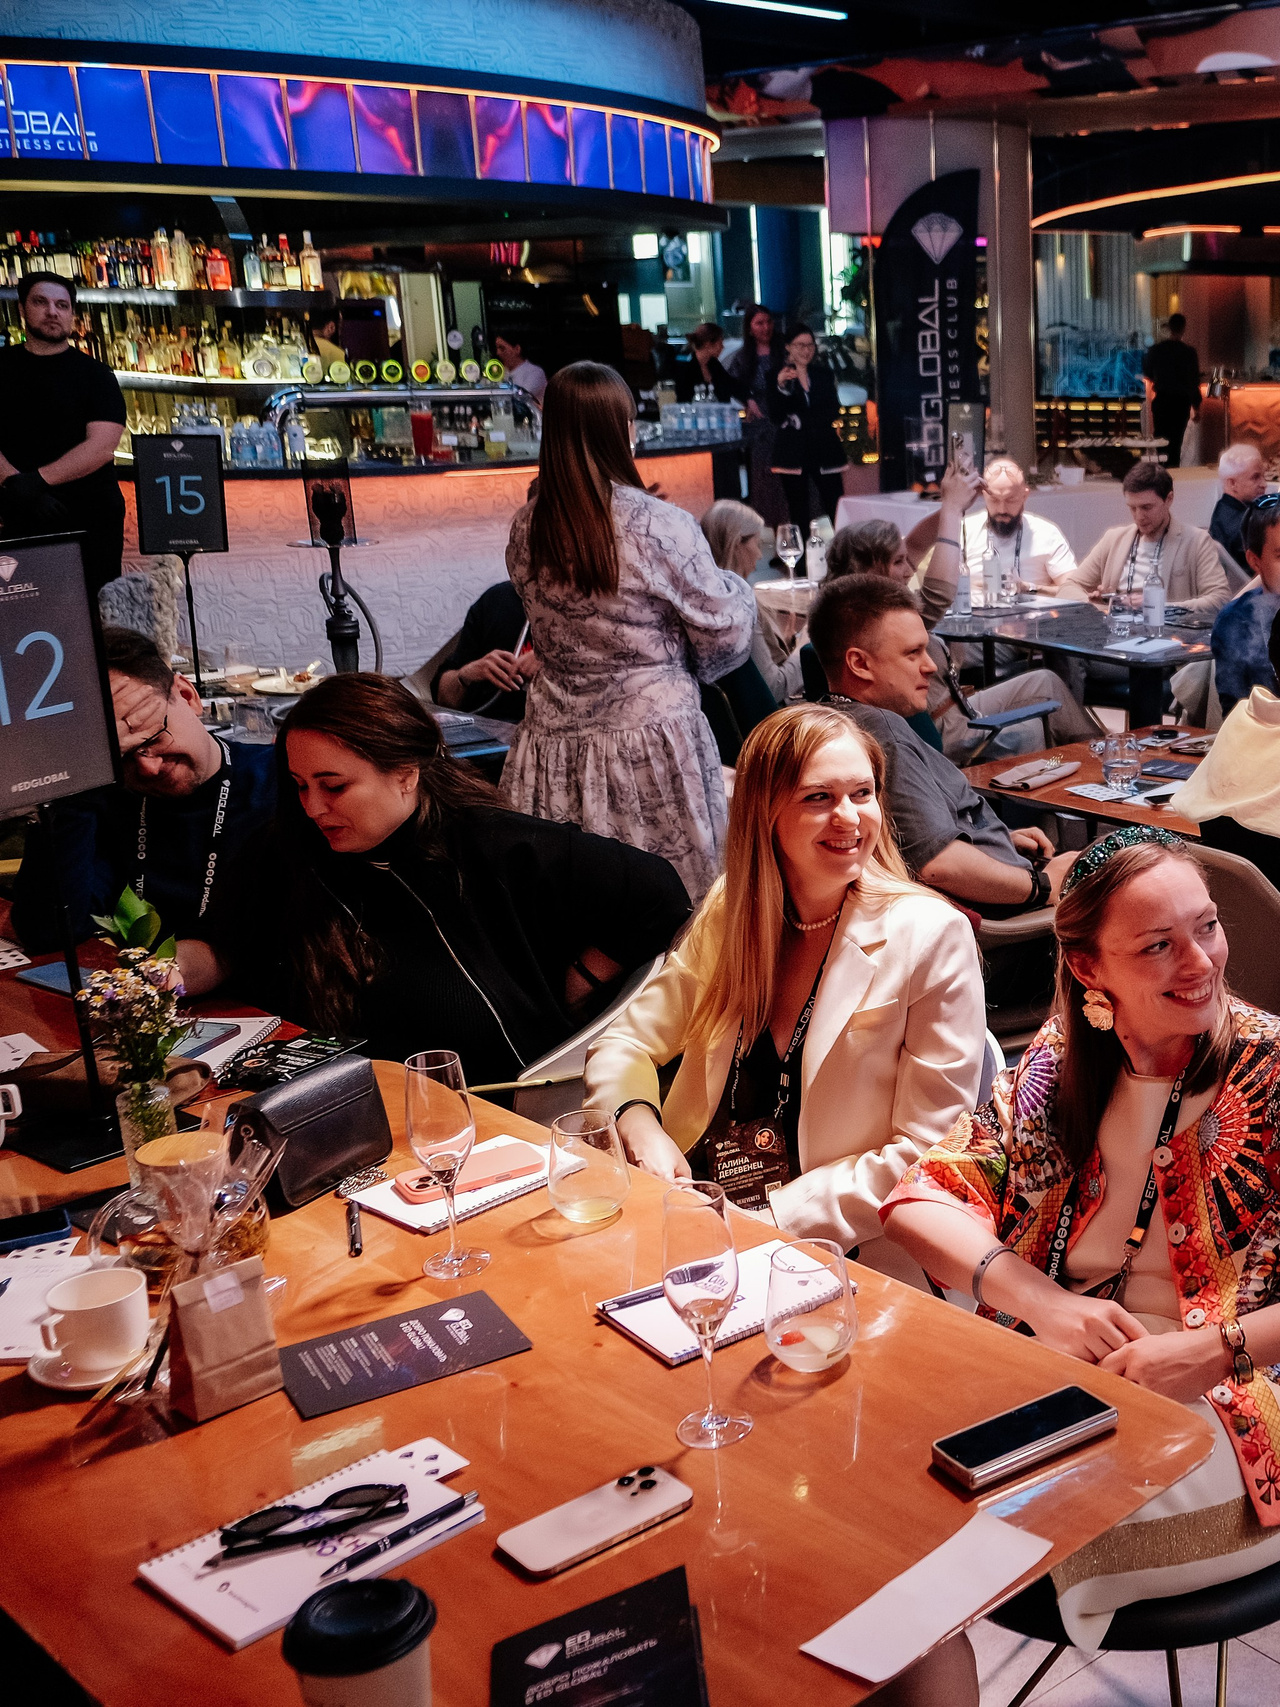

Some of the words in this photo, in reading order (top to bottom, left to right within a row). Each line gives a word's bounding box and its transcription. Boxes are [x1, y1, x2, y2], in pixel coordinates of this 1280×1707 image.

[155, 475, 206, 515] 15
[0, 631, 75, 727] 12
[11, 770, 71, 794] #EDGLOBAL
[212, 786, 230, 838] EDGLOBAL
[717, 1156, 750, 1171] ГАЛИНА
[718, 1160, 764, 1180] ДЕРЕВЕНЕЦ
[564, 1629, 591, 1647] ED
[525, 1670, 571, 1698] ДОБРО
[571, 1638, 659, 1681] ПОЖАЛОВАТЬ
